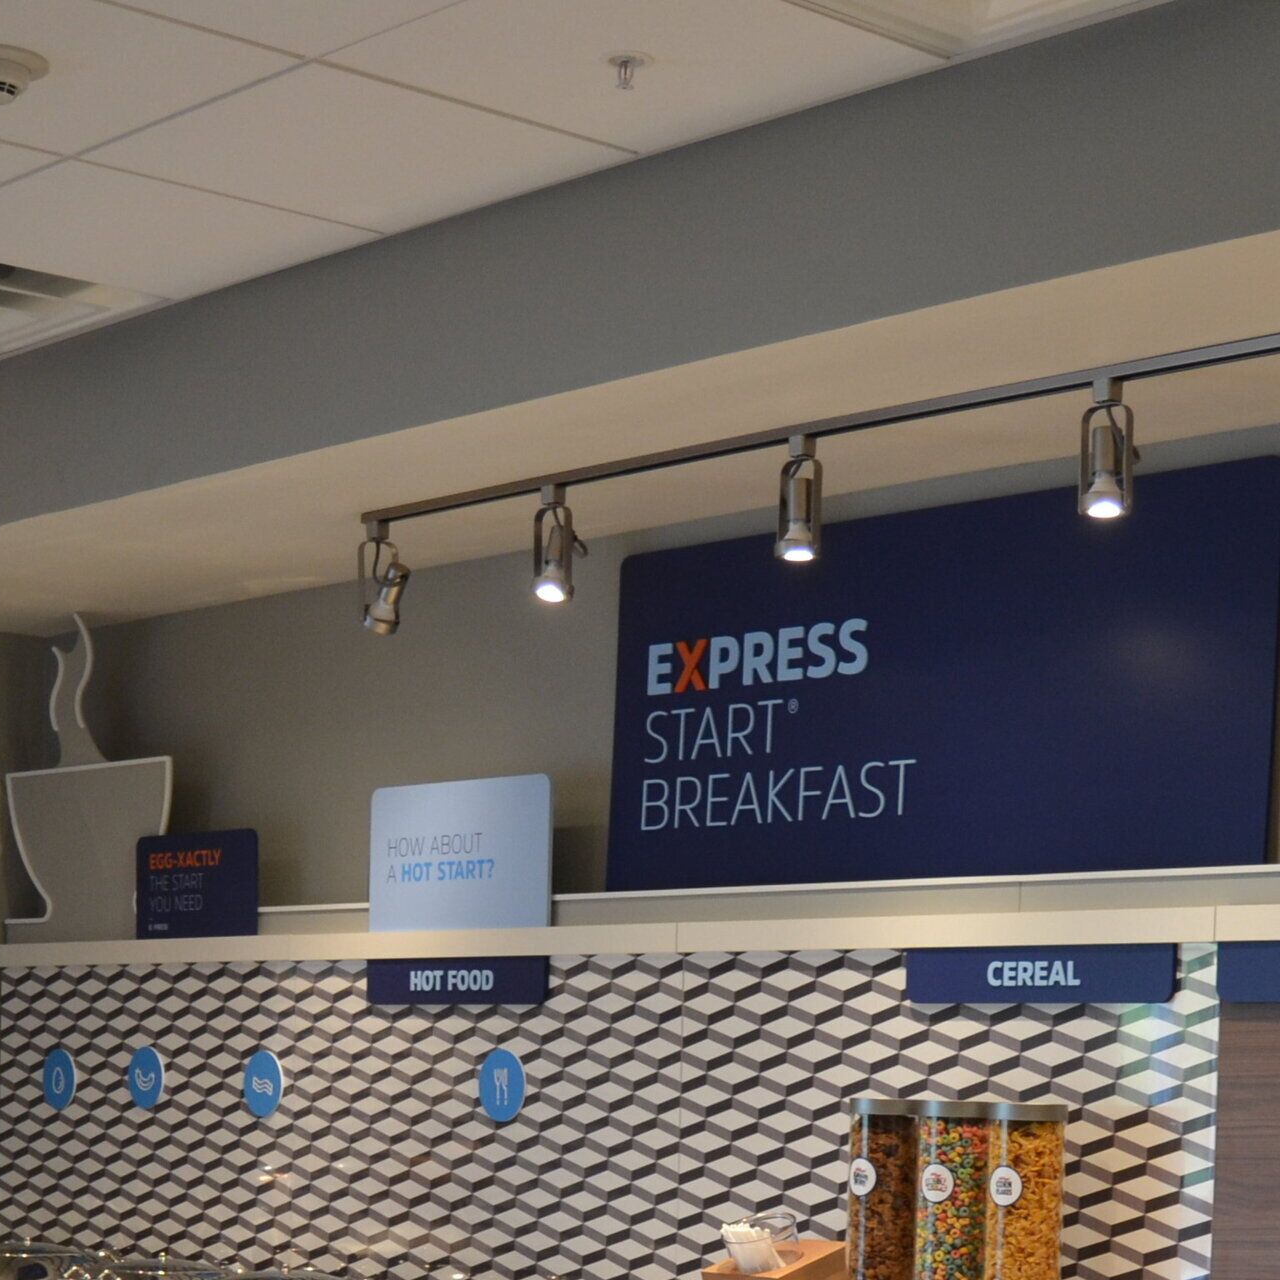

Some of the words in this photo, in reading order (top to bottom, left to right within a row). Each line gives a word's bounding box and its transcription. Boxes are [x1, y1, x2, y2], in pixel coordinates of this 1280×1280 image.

[647, 618, 868, 696] EXPRESS
[640, 759, 917, 831] BREAKFAST
[387, 837, 425, 857] HOW
[431, 832, 482, 855] ABOUT
[149, 849, 221, 869] EGG-XACTLY
[386, 864, 397, 884] A
[401, 862, 432, 882] HOT
[437, 859, 495, 880] START?
[150, 875, 169, 891] THE
[172, 873, 204, 890] START
[149, 896, 171, 912] YOU
[174, 894, 203, 911] NEED
[409, 969, 443, 991] HOT
[447, 969, 494, 991] FOOD
[986, 960, 1081, 987] CEREAL
